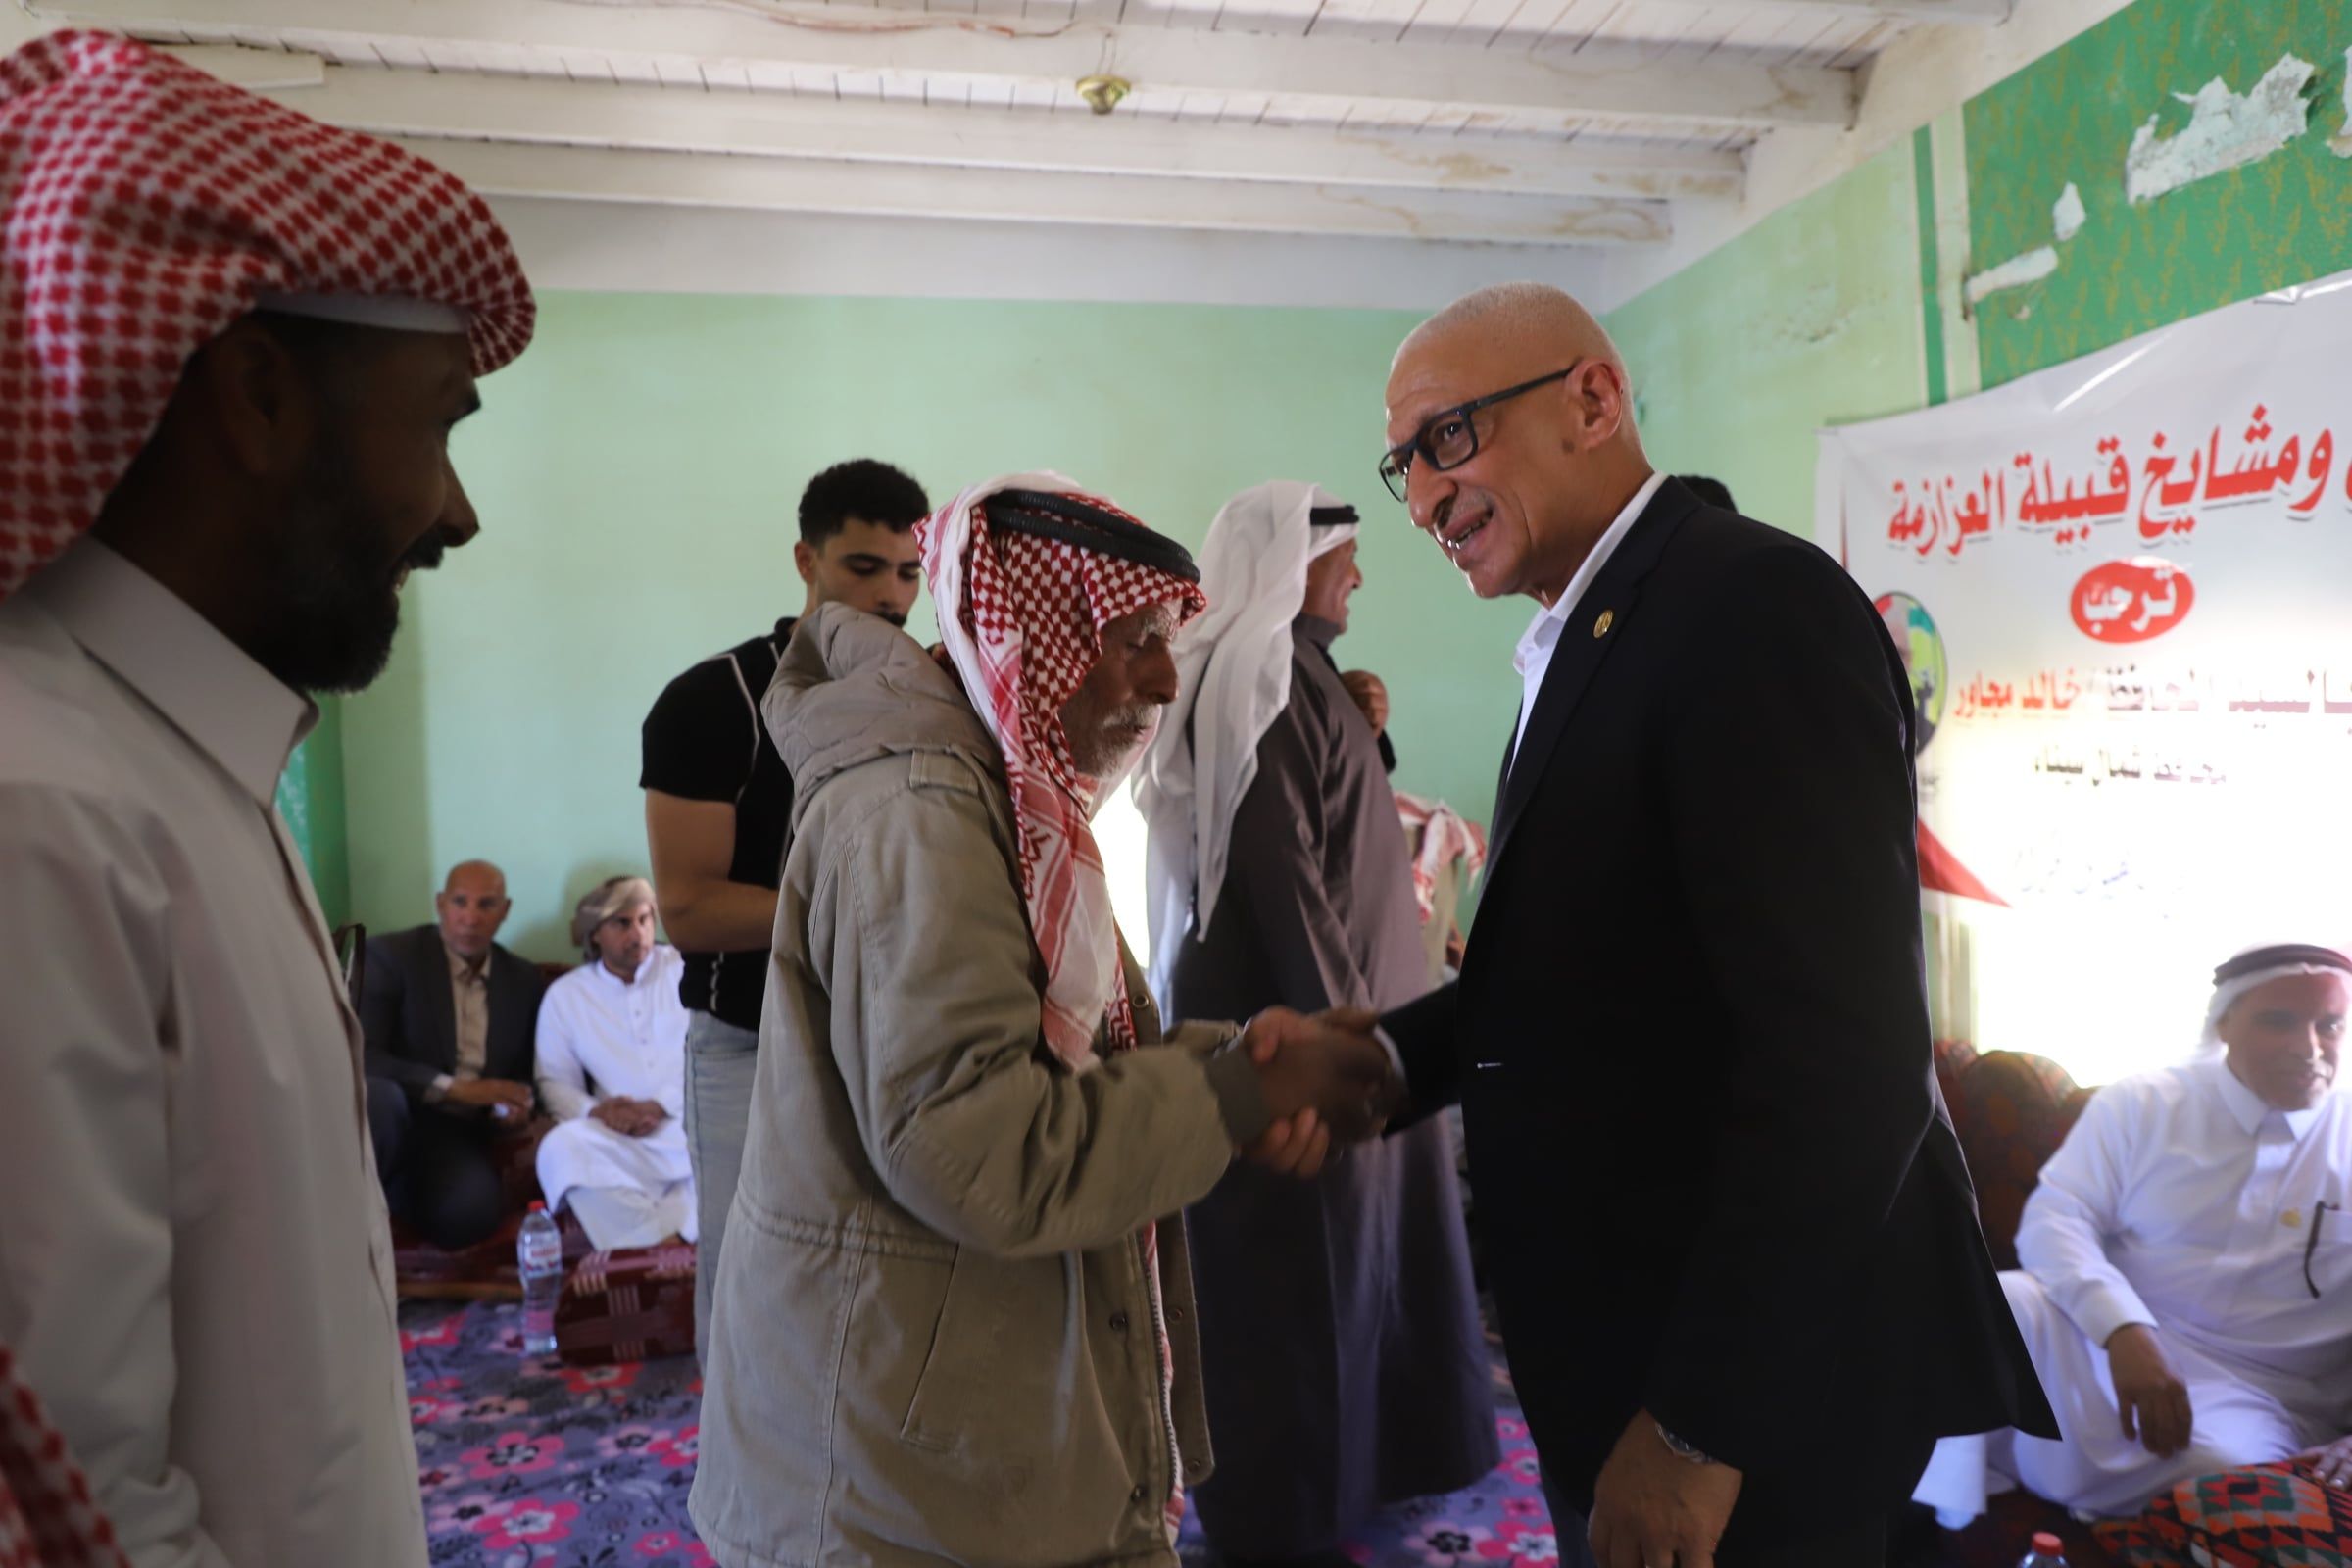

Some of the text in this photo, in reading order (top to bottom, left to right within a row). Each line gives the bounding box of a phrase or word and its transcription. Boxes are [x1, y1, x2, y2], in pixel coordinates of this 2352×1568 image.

[1887, 466, 2006, 557] العزازمة
[2014, 435, 2131, 545] قبيلة
[2138, 402, 2334, 539] ومشايخ
[2022, 666, 2082, 710] خالد
